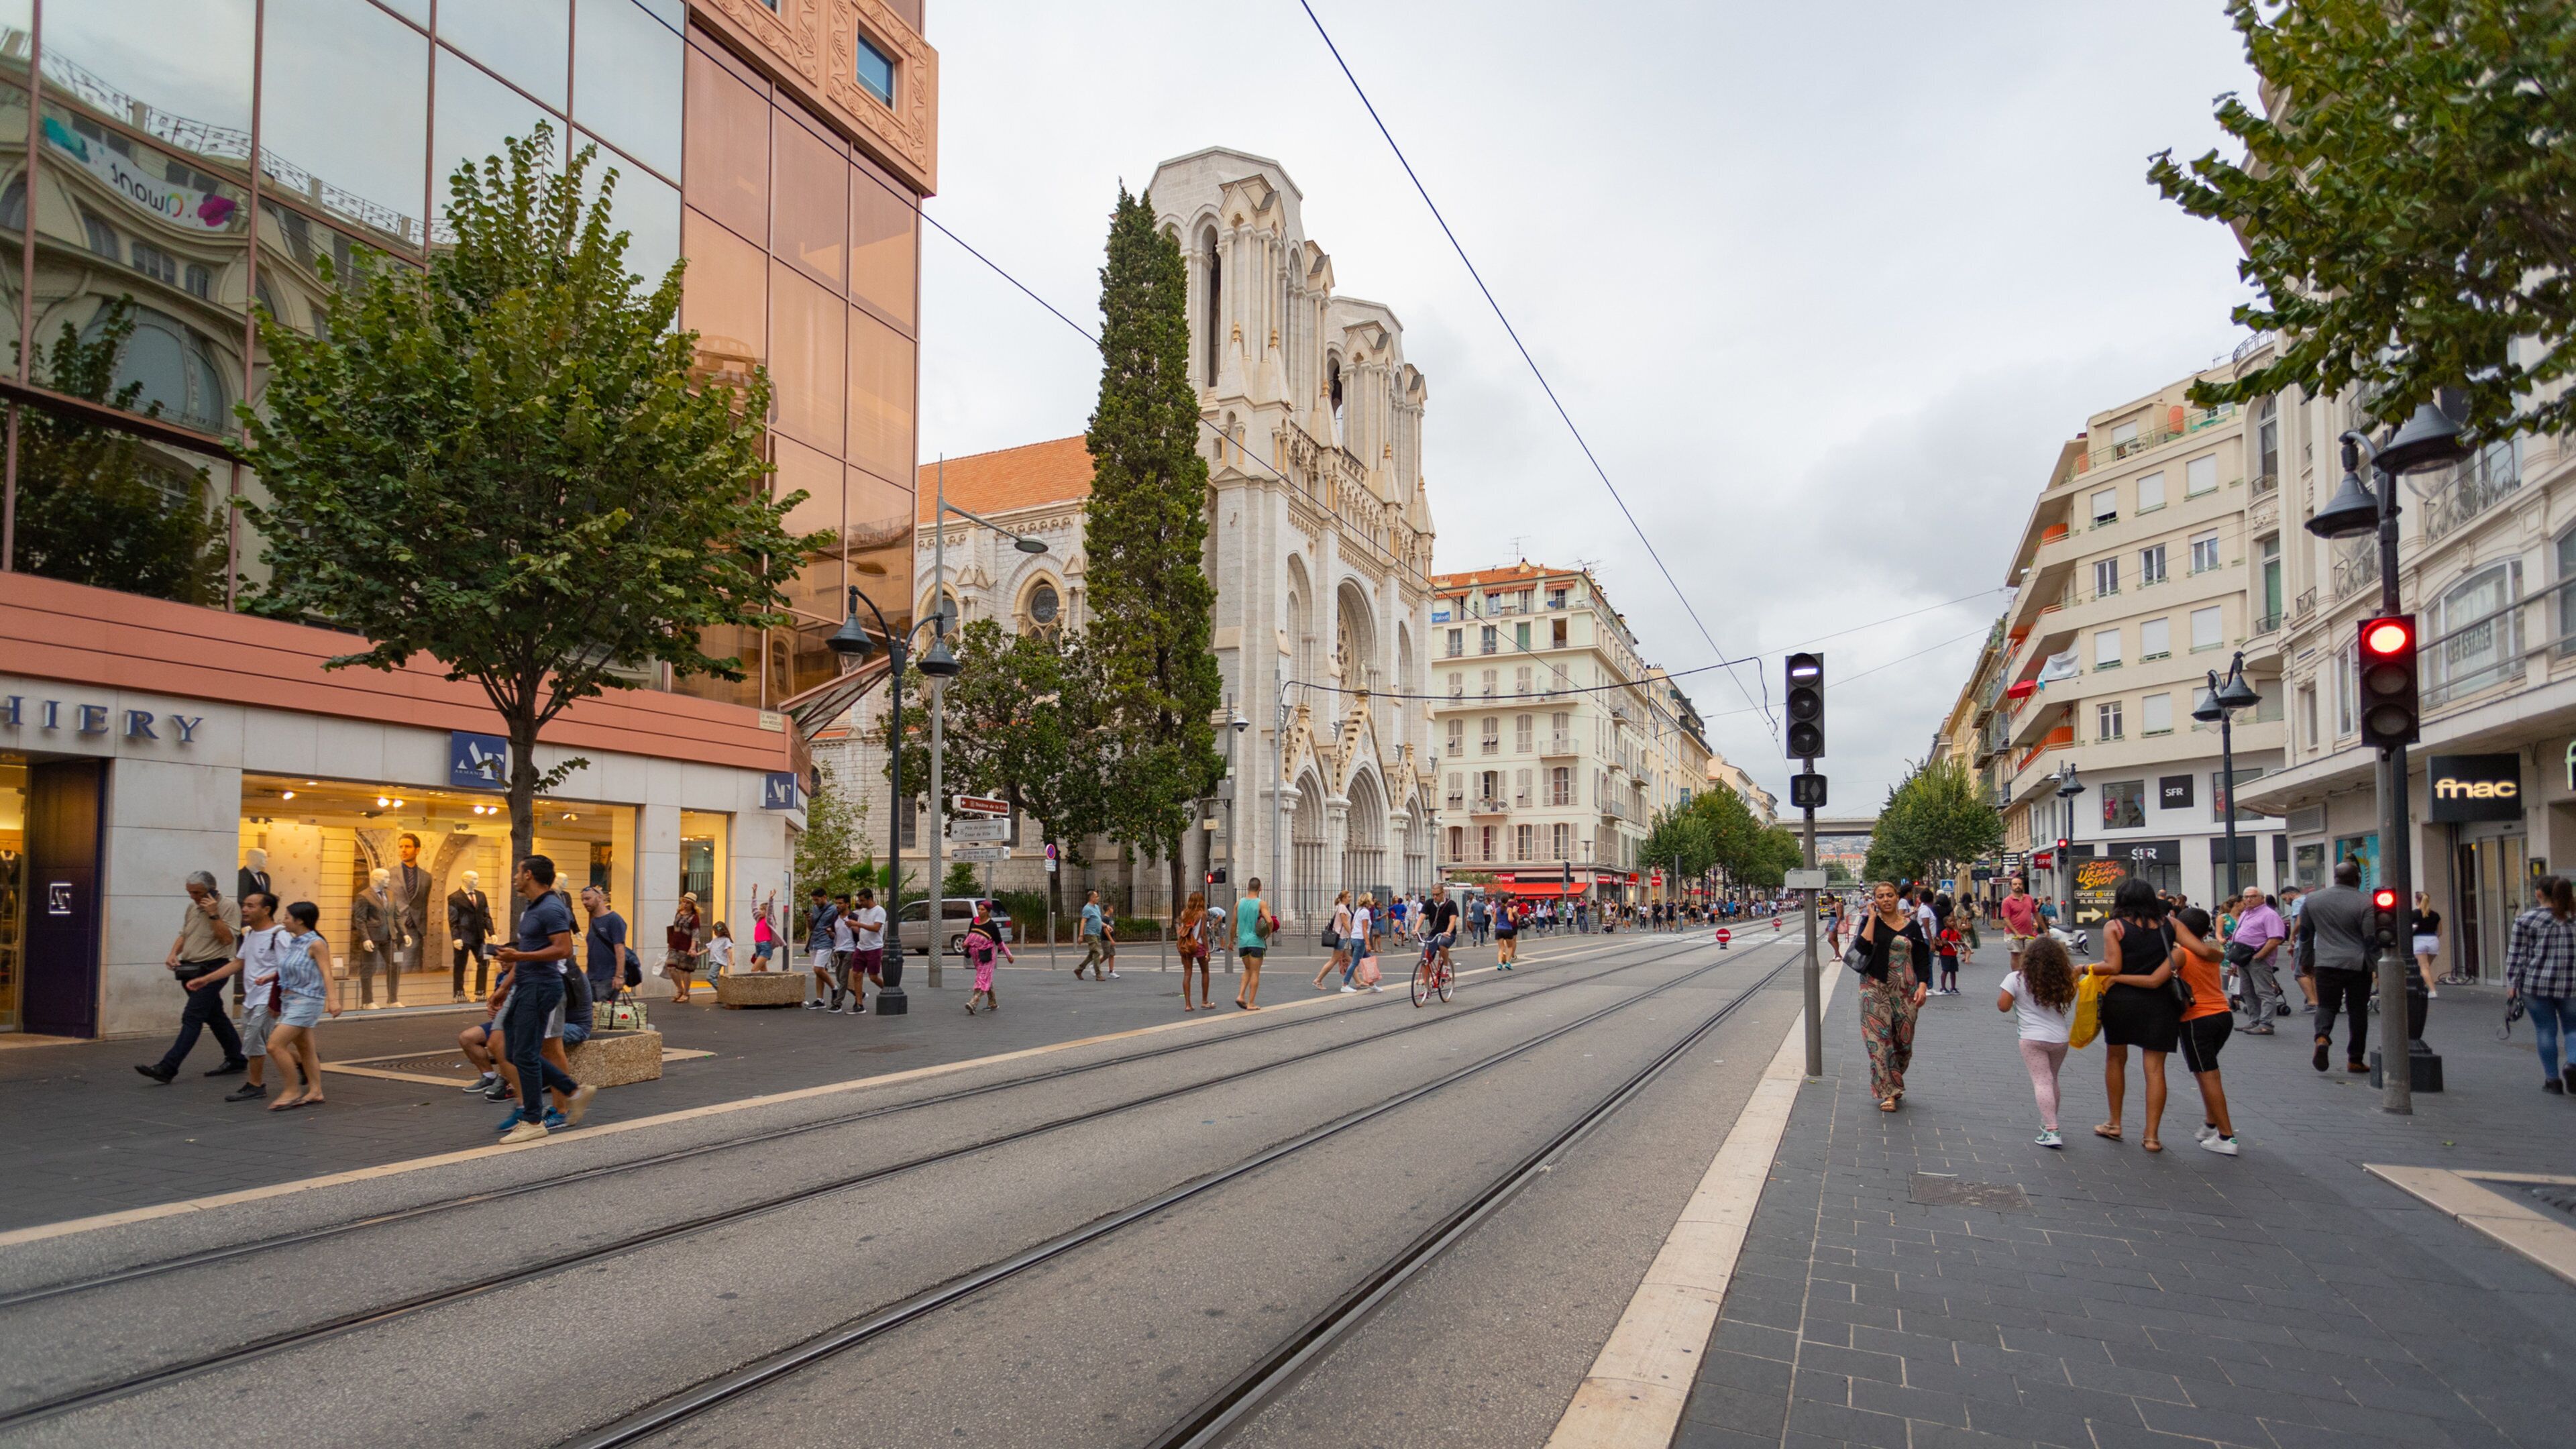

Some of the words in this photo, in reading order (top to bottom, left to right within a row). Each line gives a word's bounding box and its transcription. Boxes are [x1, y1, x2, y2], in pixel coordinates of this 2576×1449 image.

[2165, 787, 2184, 797] SFR
[2434, 777, 2517, 799] fnac
[2131, 847, 2157, 861] SFR
[2082, 875, 2117, 890] SHOP
